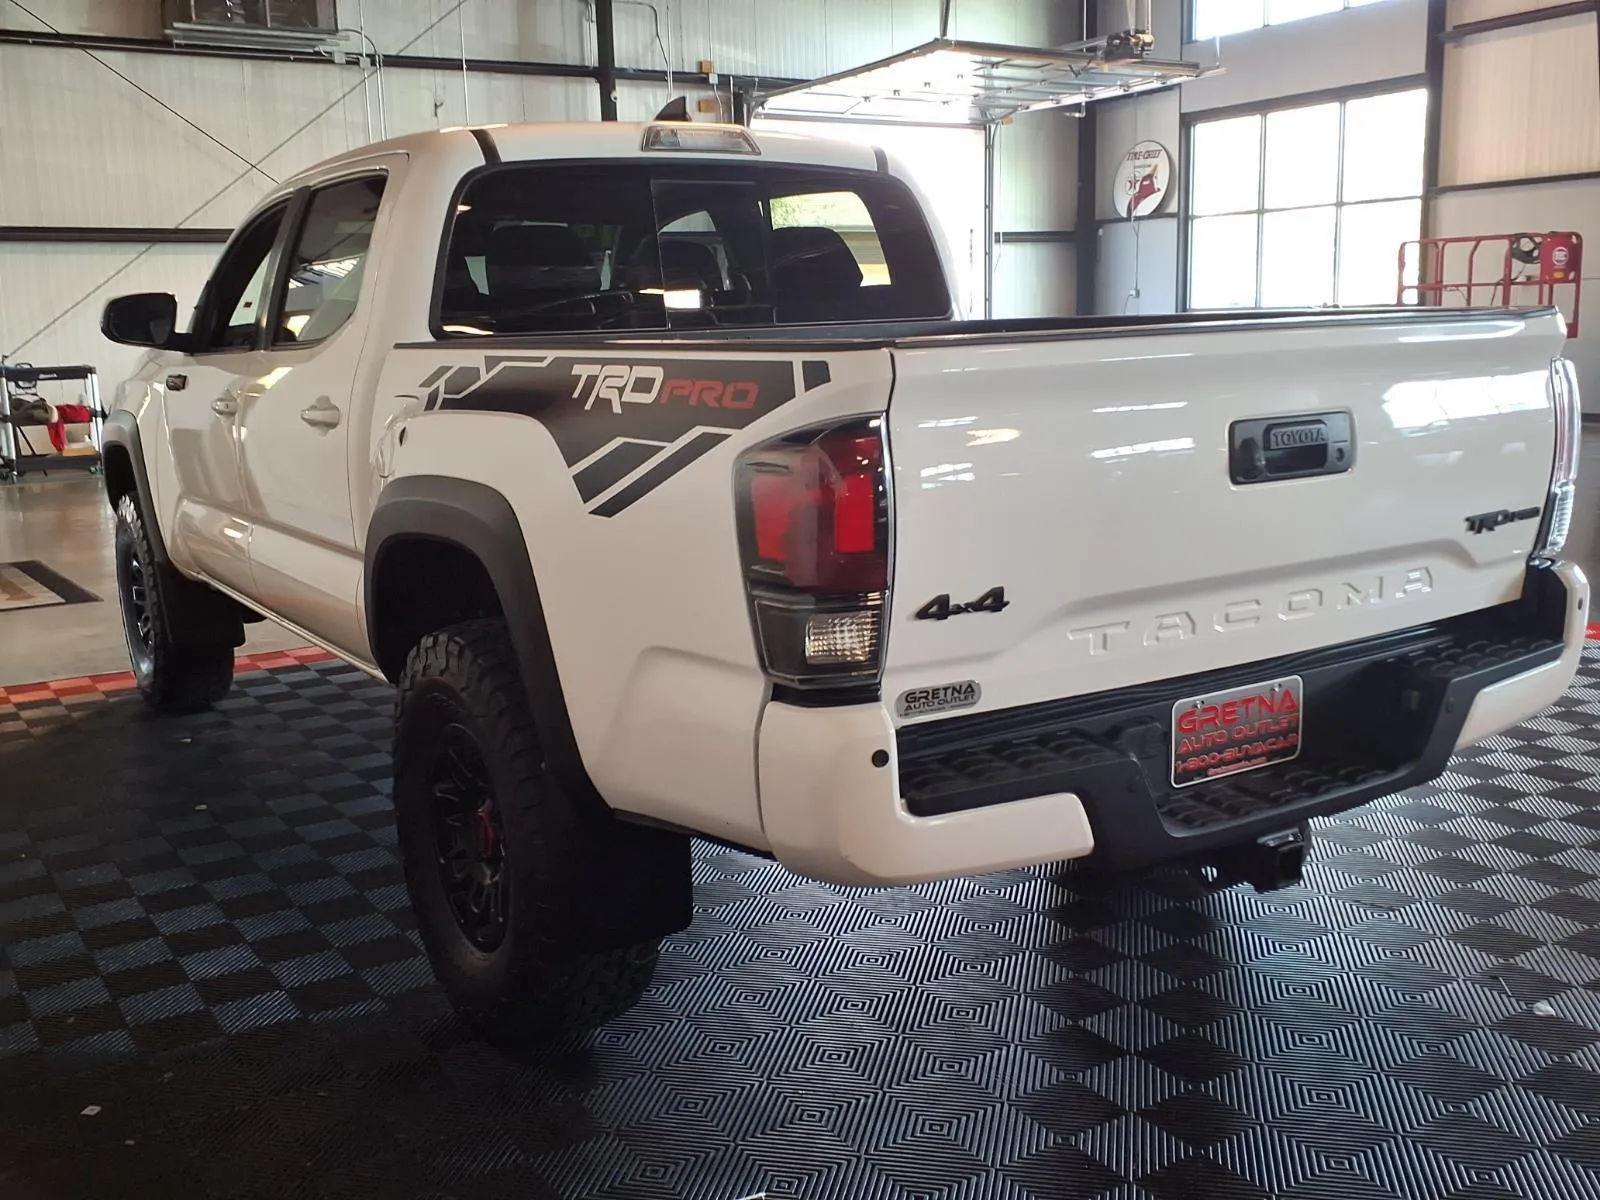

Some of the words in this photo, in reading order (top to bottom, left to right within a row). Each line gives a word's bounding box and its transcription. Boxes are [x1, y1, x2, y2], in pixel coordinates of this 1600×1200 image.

[571, 364, 664, 414] TRD
[660, 379, 760, 410] PRO
[1272, 427, 1327, 447] TOYOTA
[1066, 566, 1433, 655] TACOMA
[904, 683, 975, 704] GRETNA
[904, 699, 935, 712] AUTO
[937, 693, 975, 706] OUTLET
[1178, 688, 1298, 733] GRETNA
[1176, 729, 1228, 754] AUTO
[1232, 713, 1300, 740] OUTLET
